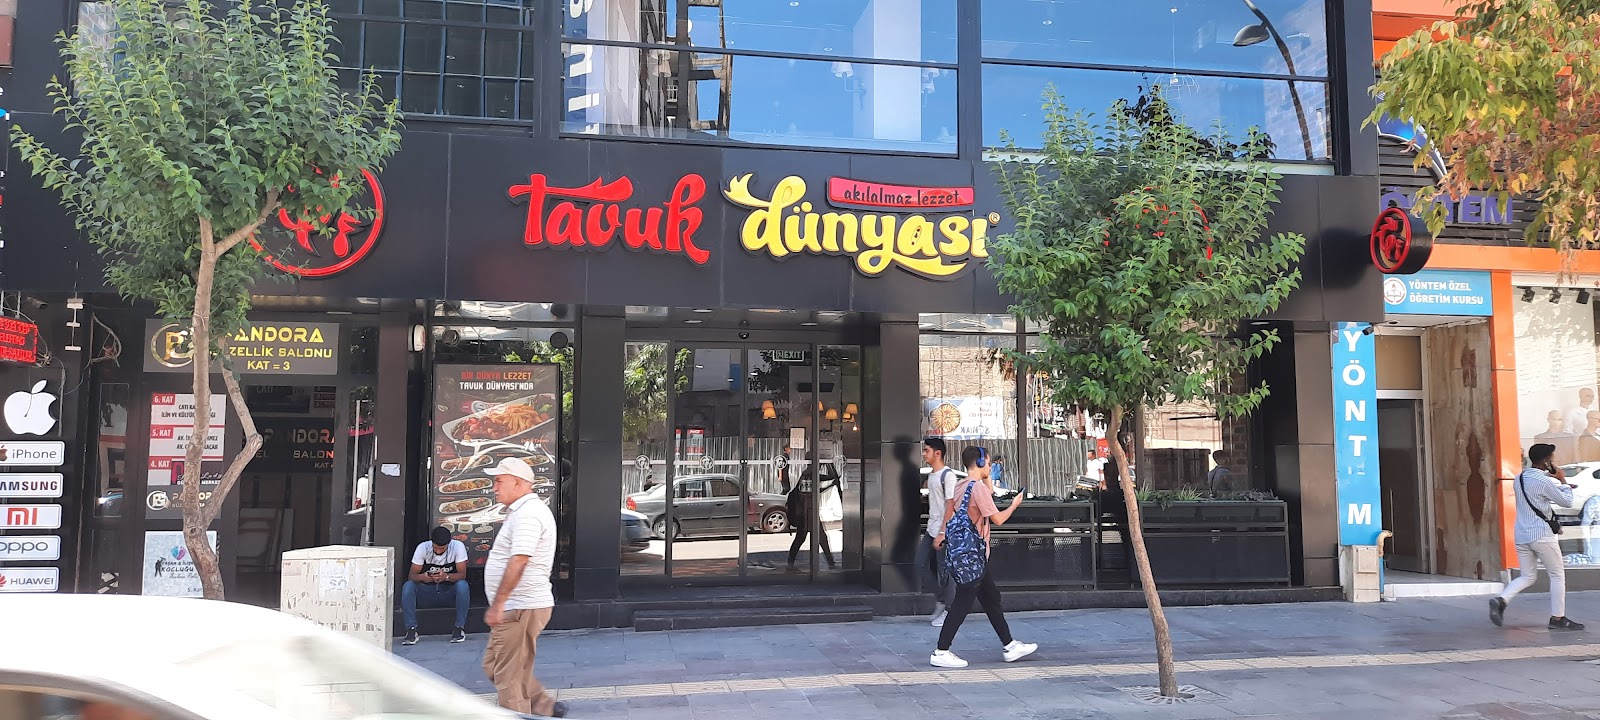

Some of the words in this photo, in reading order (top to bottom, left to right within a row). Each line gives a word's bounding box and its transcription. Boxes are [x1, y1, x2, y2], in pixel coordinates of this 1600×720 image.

[844, 184, 912, 205] akılalmaz
[917, 189, 960, 206] lezzet
[508, 173, 710, 265] Tavuk
[723, 172, 991, 278] dünyası
[1408, 279, 1447, 291] YÖNTEM
[1448, 280, 1472, 292] ÖZEL
[1409, 293, 1452, 304] ÖĞRETİM
[1452, 295, 1484, 305] KURSU
[227, 326, 324, 342] ANDORA
[278, 347, 332, 358] SALONU
[247, 360, 271, 370] KAT
[283, 361, 291, 371] 3
[503, 372, 532, 380] LEZZET
[459, 382, 484, 391] TAVUK
[161, 395, 173, 403] KAT
[1342, 330, 1373, 525] YÖNTM
[12, 449, 57, 459] iPhone
[293, 450, 334, 459] SALON
[158, 460, 170, 468] KAT
[0, 481, 58, 491] AMSUNG
[10, 577, 54, 585] HUAWEI
